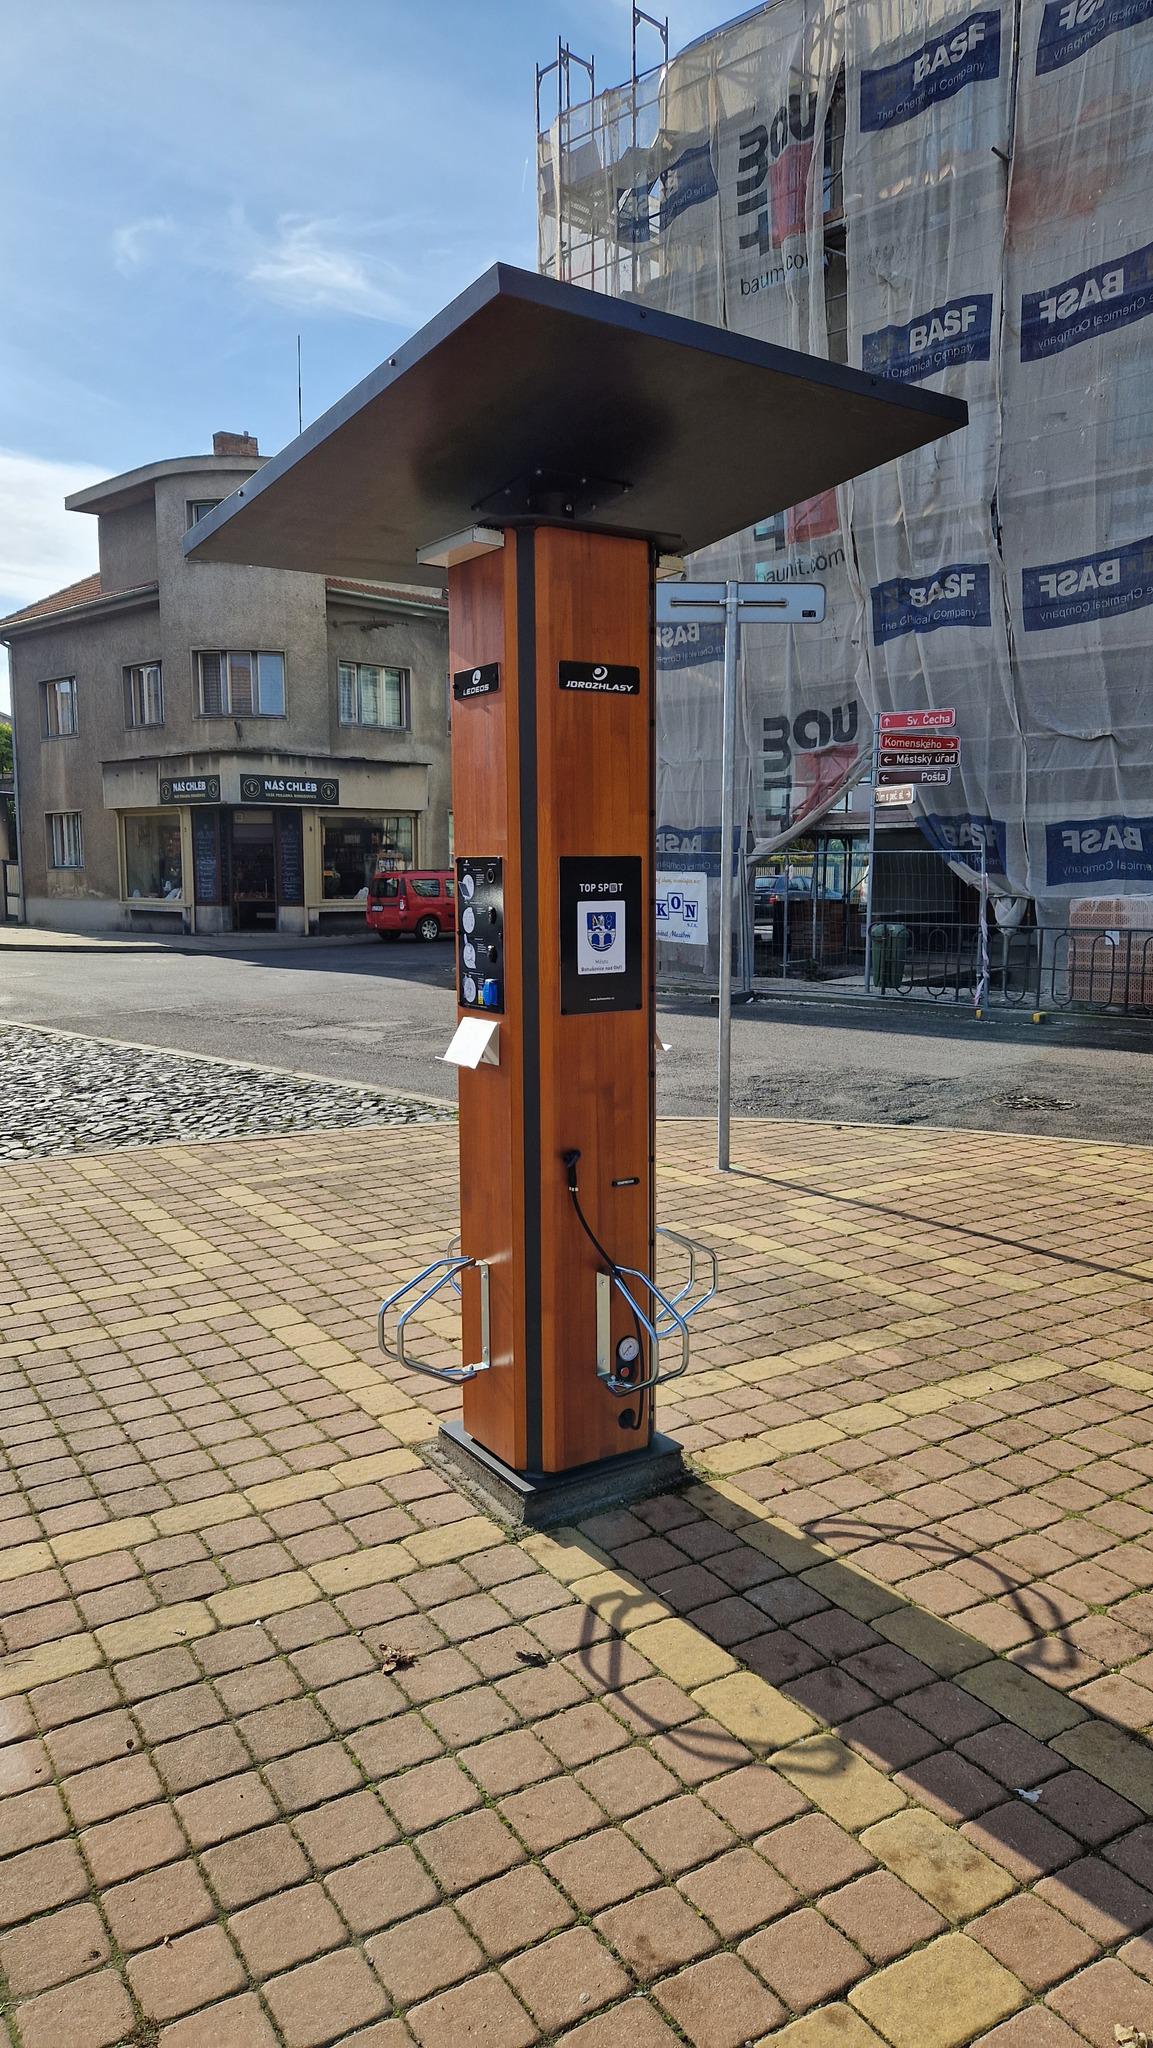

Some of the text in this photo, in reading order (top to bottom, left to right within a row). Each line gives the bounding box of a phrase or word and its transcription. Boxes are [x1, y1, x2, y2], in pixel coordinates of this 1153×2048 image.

[913, 22, 985, 91] BASF
[939, 62, 985, 92] Company
[909, 304, 978, 354] BASF
[909, 573, 976, 608] BASF
[933, 607, 977, 620] Company
[463, 684, 490, 696] LEDEOS
[907, 713, 951, 726] Sv. Čecha
[884, 737, 942, 749] Komenského
[896, 753, 956, 766] Městský úřad
[921, 771, 947, 782] Pošta
[185, 780, 207, 791] CHLÉB
[264, 779, 318, 792] NÁŠ CHLÉB
[579, 883, 596, 893] TOP
